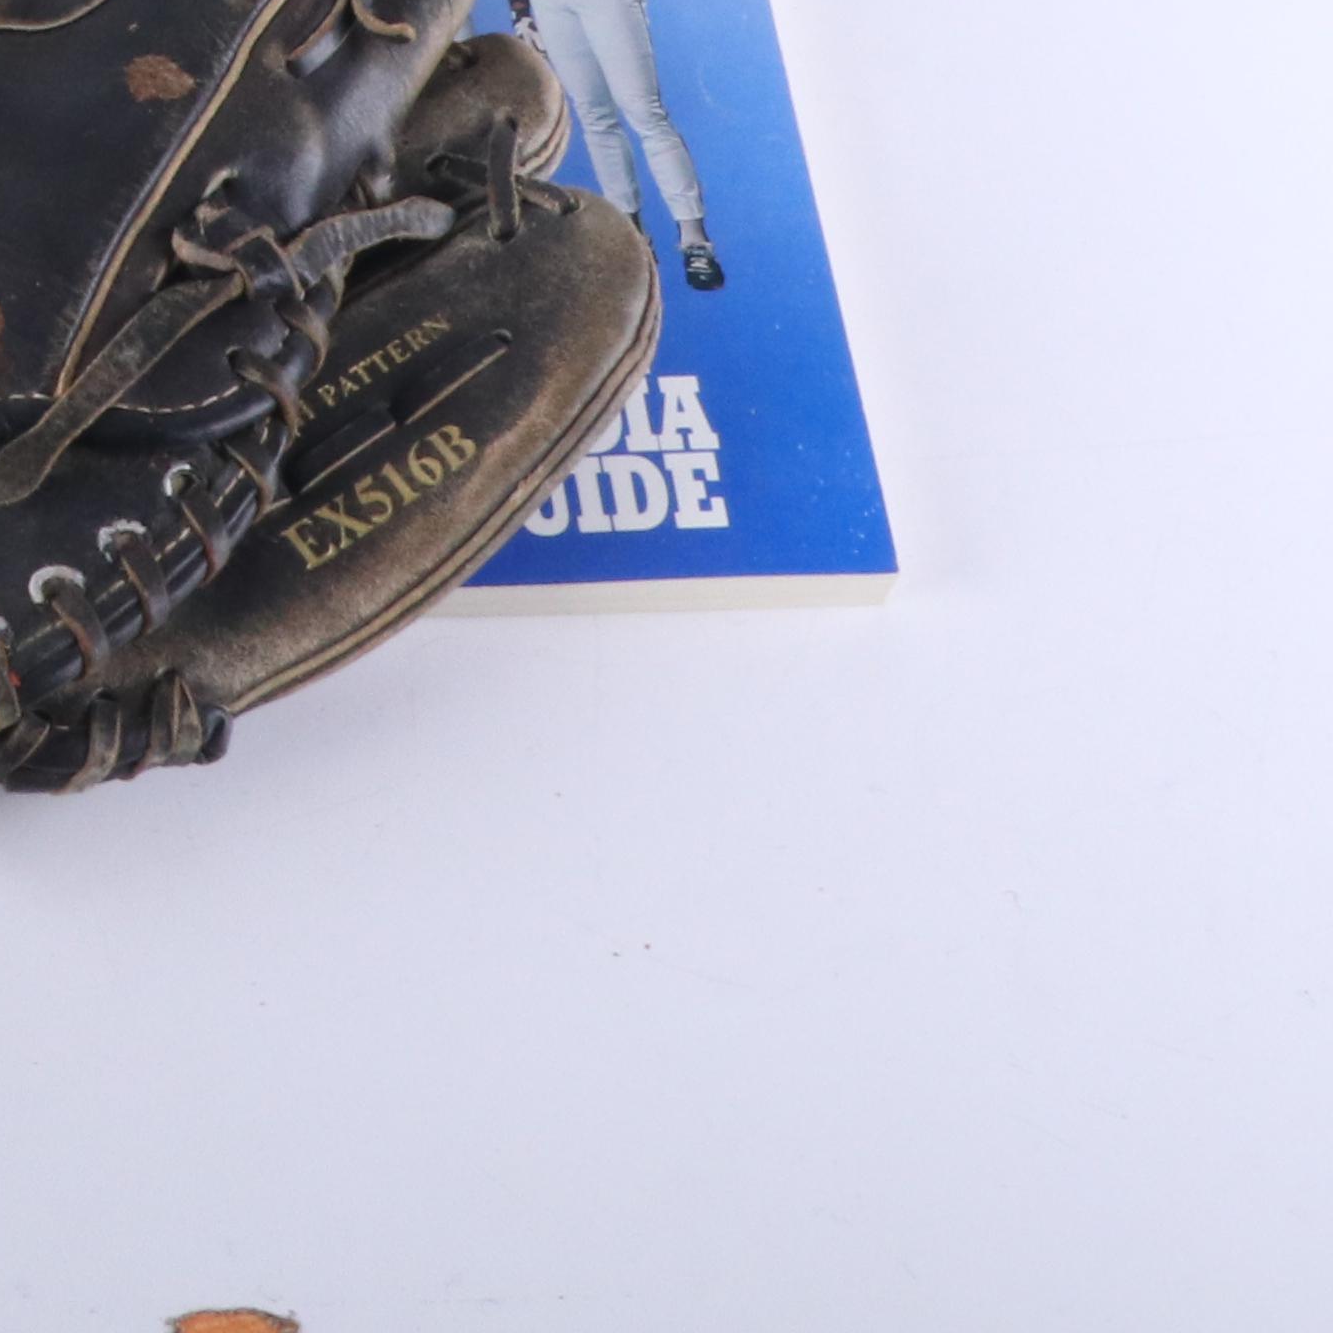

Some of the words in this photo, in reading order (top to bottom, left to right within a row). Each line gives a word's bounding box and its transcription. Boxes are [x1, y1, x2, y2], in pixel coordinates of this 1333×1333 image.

[317, 313, 454, 409] PATTERN
[279, 422, 479, 570] EX516B
[523, 451, 730, 537] UIDE
